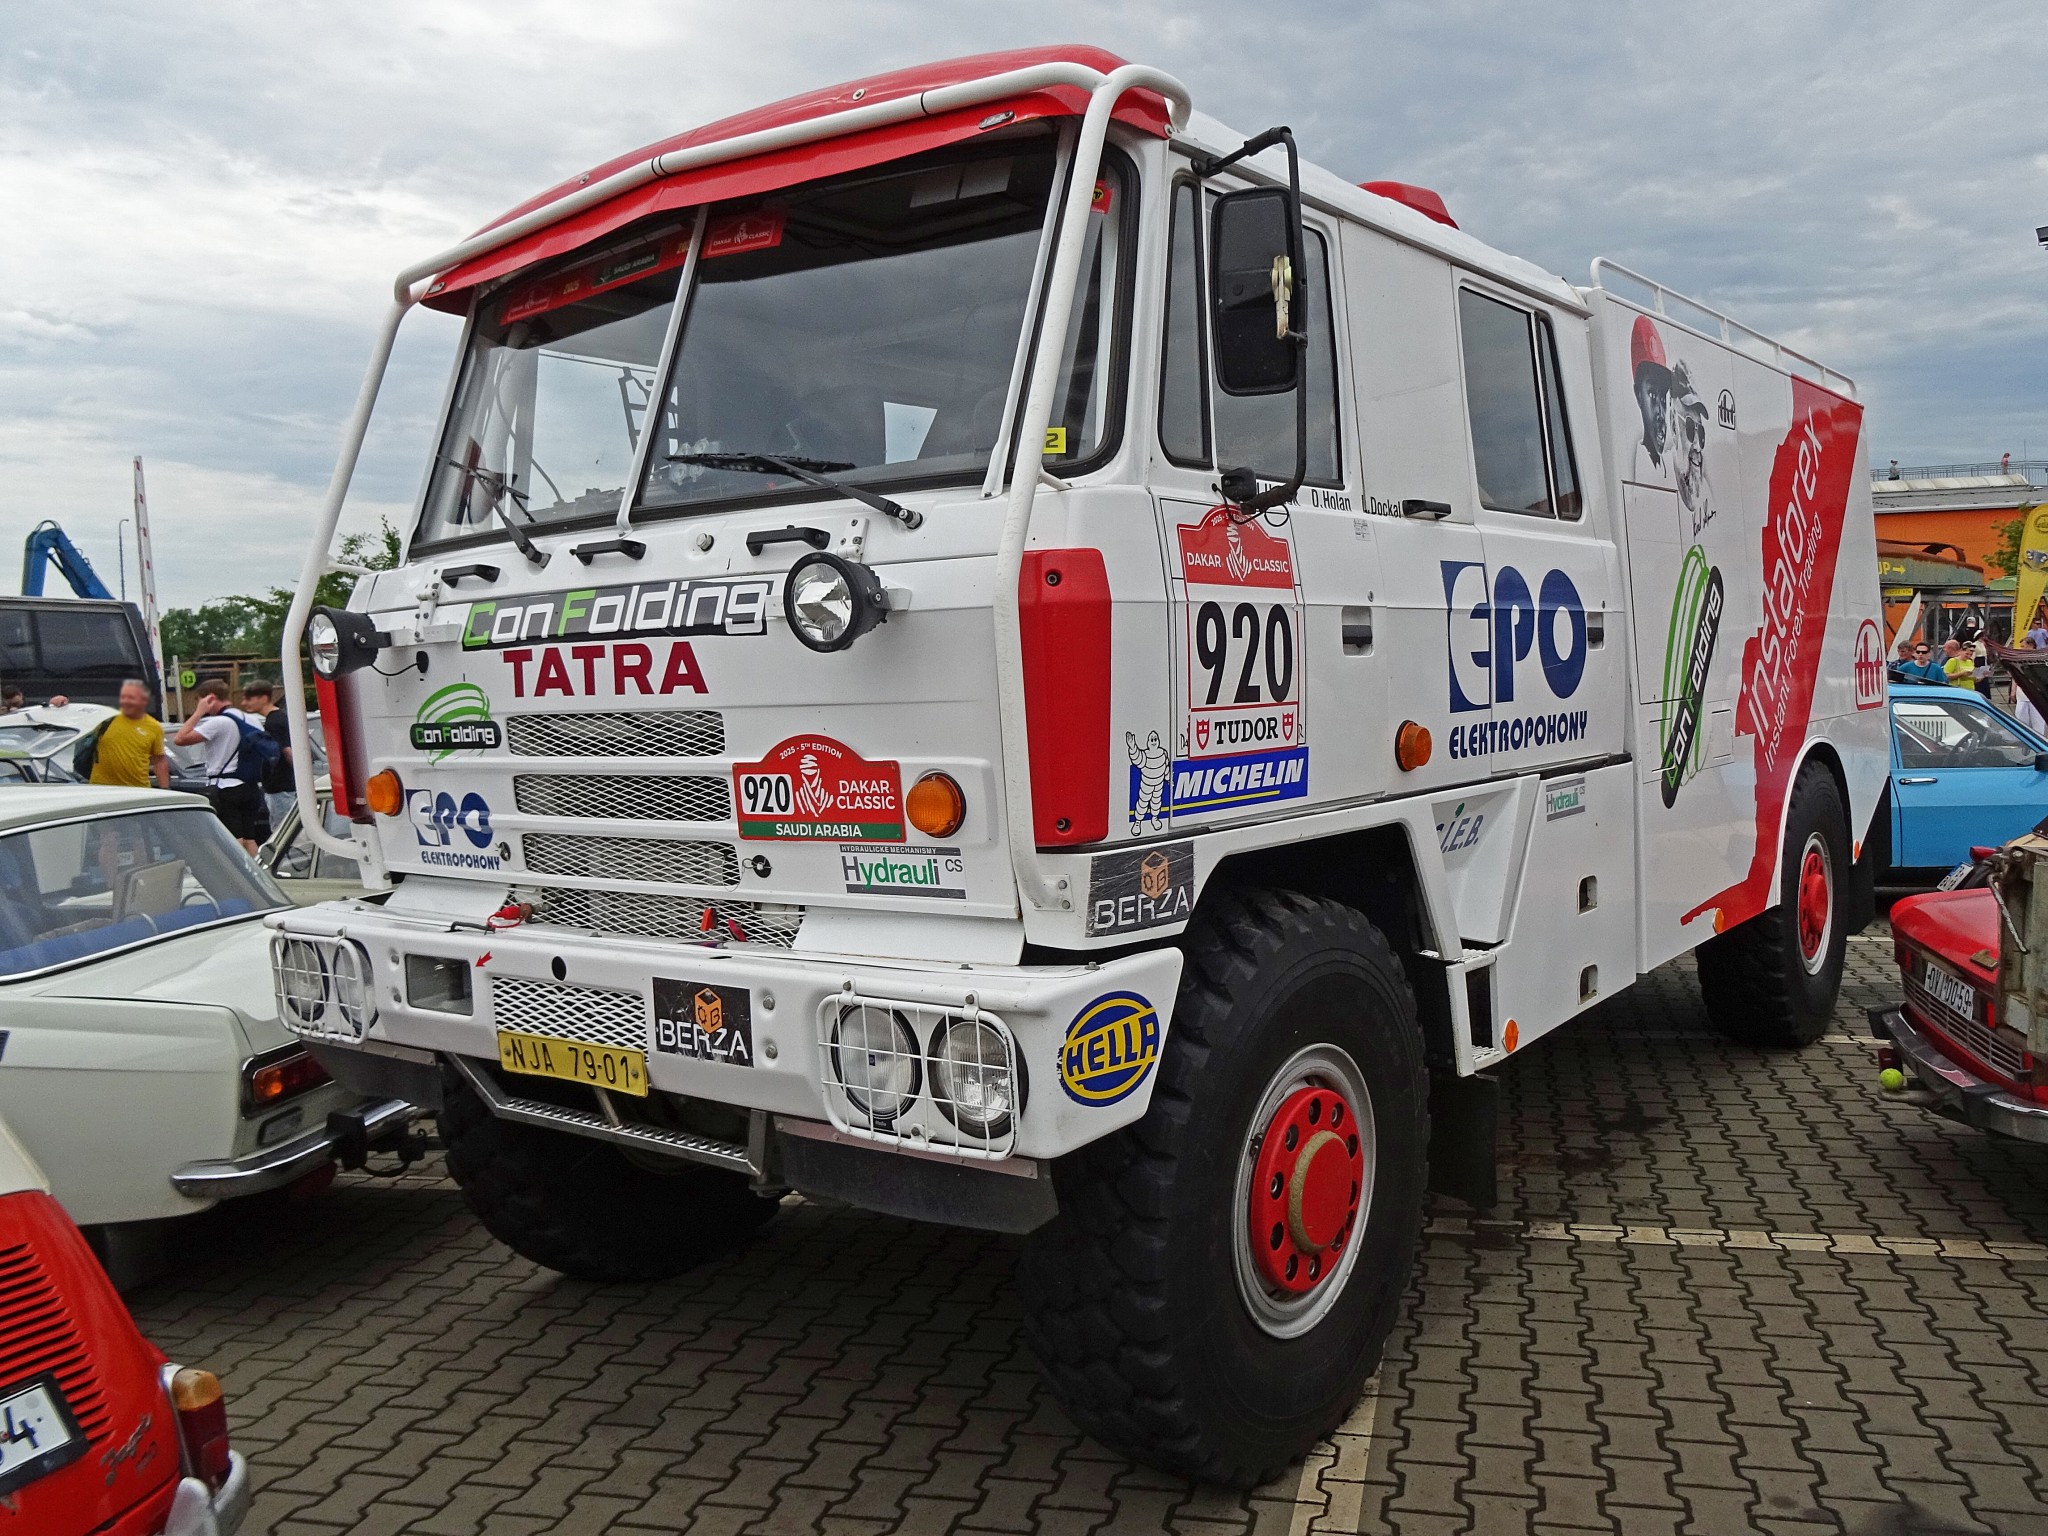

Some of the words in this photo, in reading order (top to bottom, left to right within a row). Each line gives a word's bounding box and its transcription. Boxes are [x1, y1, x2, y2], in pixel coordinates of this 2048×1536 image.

[1311, 488, 1352, 512] D.Holan
[1187, 552, 1221, 568] DAKAR
[1253, 558, 1289, 573] CLASSIC
[1743, 405, 1823, 747] instaforex
[464, 581, 774, 647] ConFolding
[1196, 600, 1293, 705] 920
[1440, 560, 1587, 714] EPO
[1765, 674, 1791, 772] Instant
[1784, 600, 1805, 678] Forex
[1799, 512, 1822, 598] Trading
[184, 675, 194, 684] 13
[503, 641, 709, 698] TATRA
[415, 726, 496, 745] ConFolding
[779, 746, 796, 760] 2025
[812, 743, 842, 759] EDITION
[1214, 717, 1279, 745] TUDOR
[1449, 710, 1588, 760] ELEKTROPOHONY
[744, 776, 790, 813] 920
[839, 780, 890, 794] DAKAR
[1174, 758, 1304, 800] MICHELIN
[405, 789, 493, 849] EPO
[837, 795, 895, 810] CLASSIC
[776, 823, 812, 837] SAUDI
[815, 824, 862, 838] ARABIA
[422, 850, 500, 870] ELEKTROPOHONY
[841, 855, 941, 890] Hydrauli
[945, 859, 963, 872] CS
[1094, 886, 1189, 929] BERZA
[658, 1018, 748, 1060] BERZA
[1066, 1013, 1158, 1078] HELLA
[511, 1037, 555, 1073] NJA
[568, 1047, 630, 1088] 79-01
